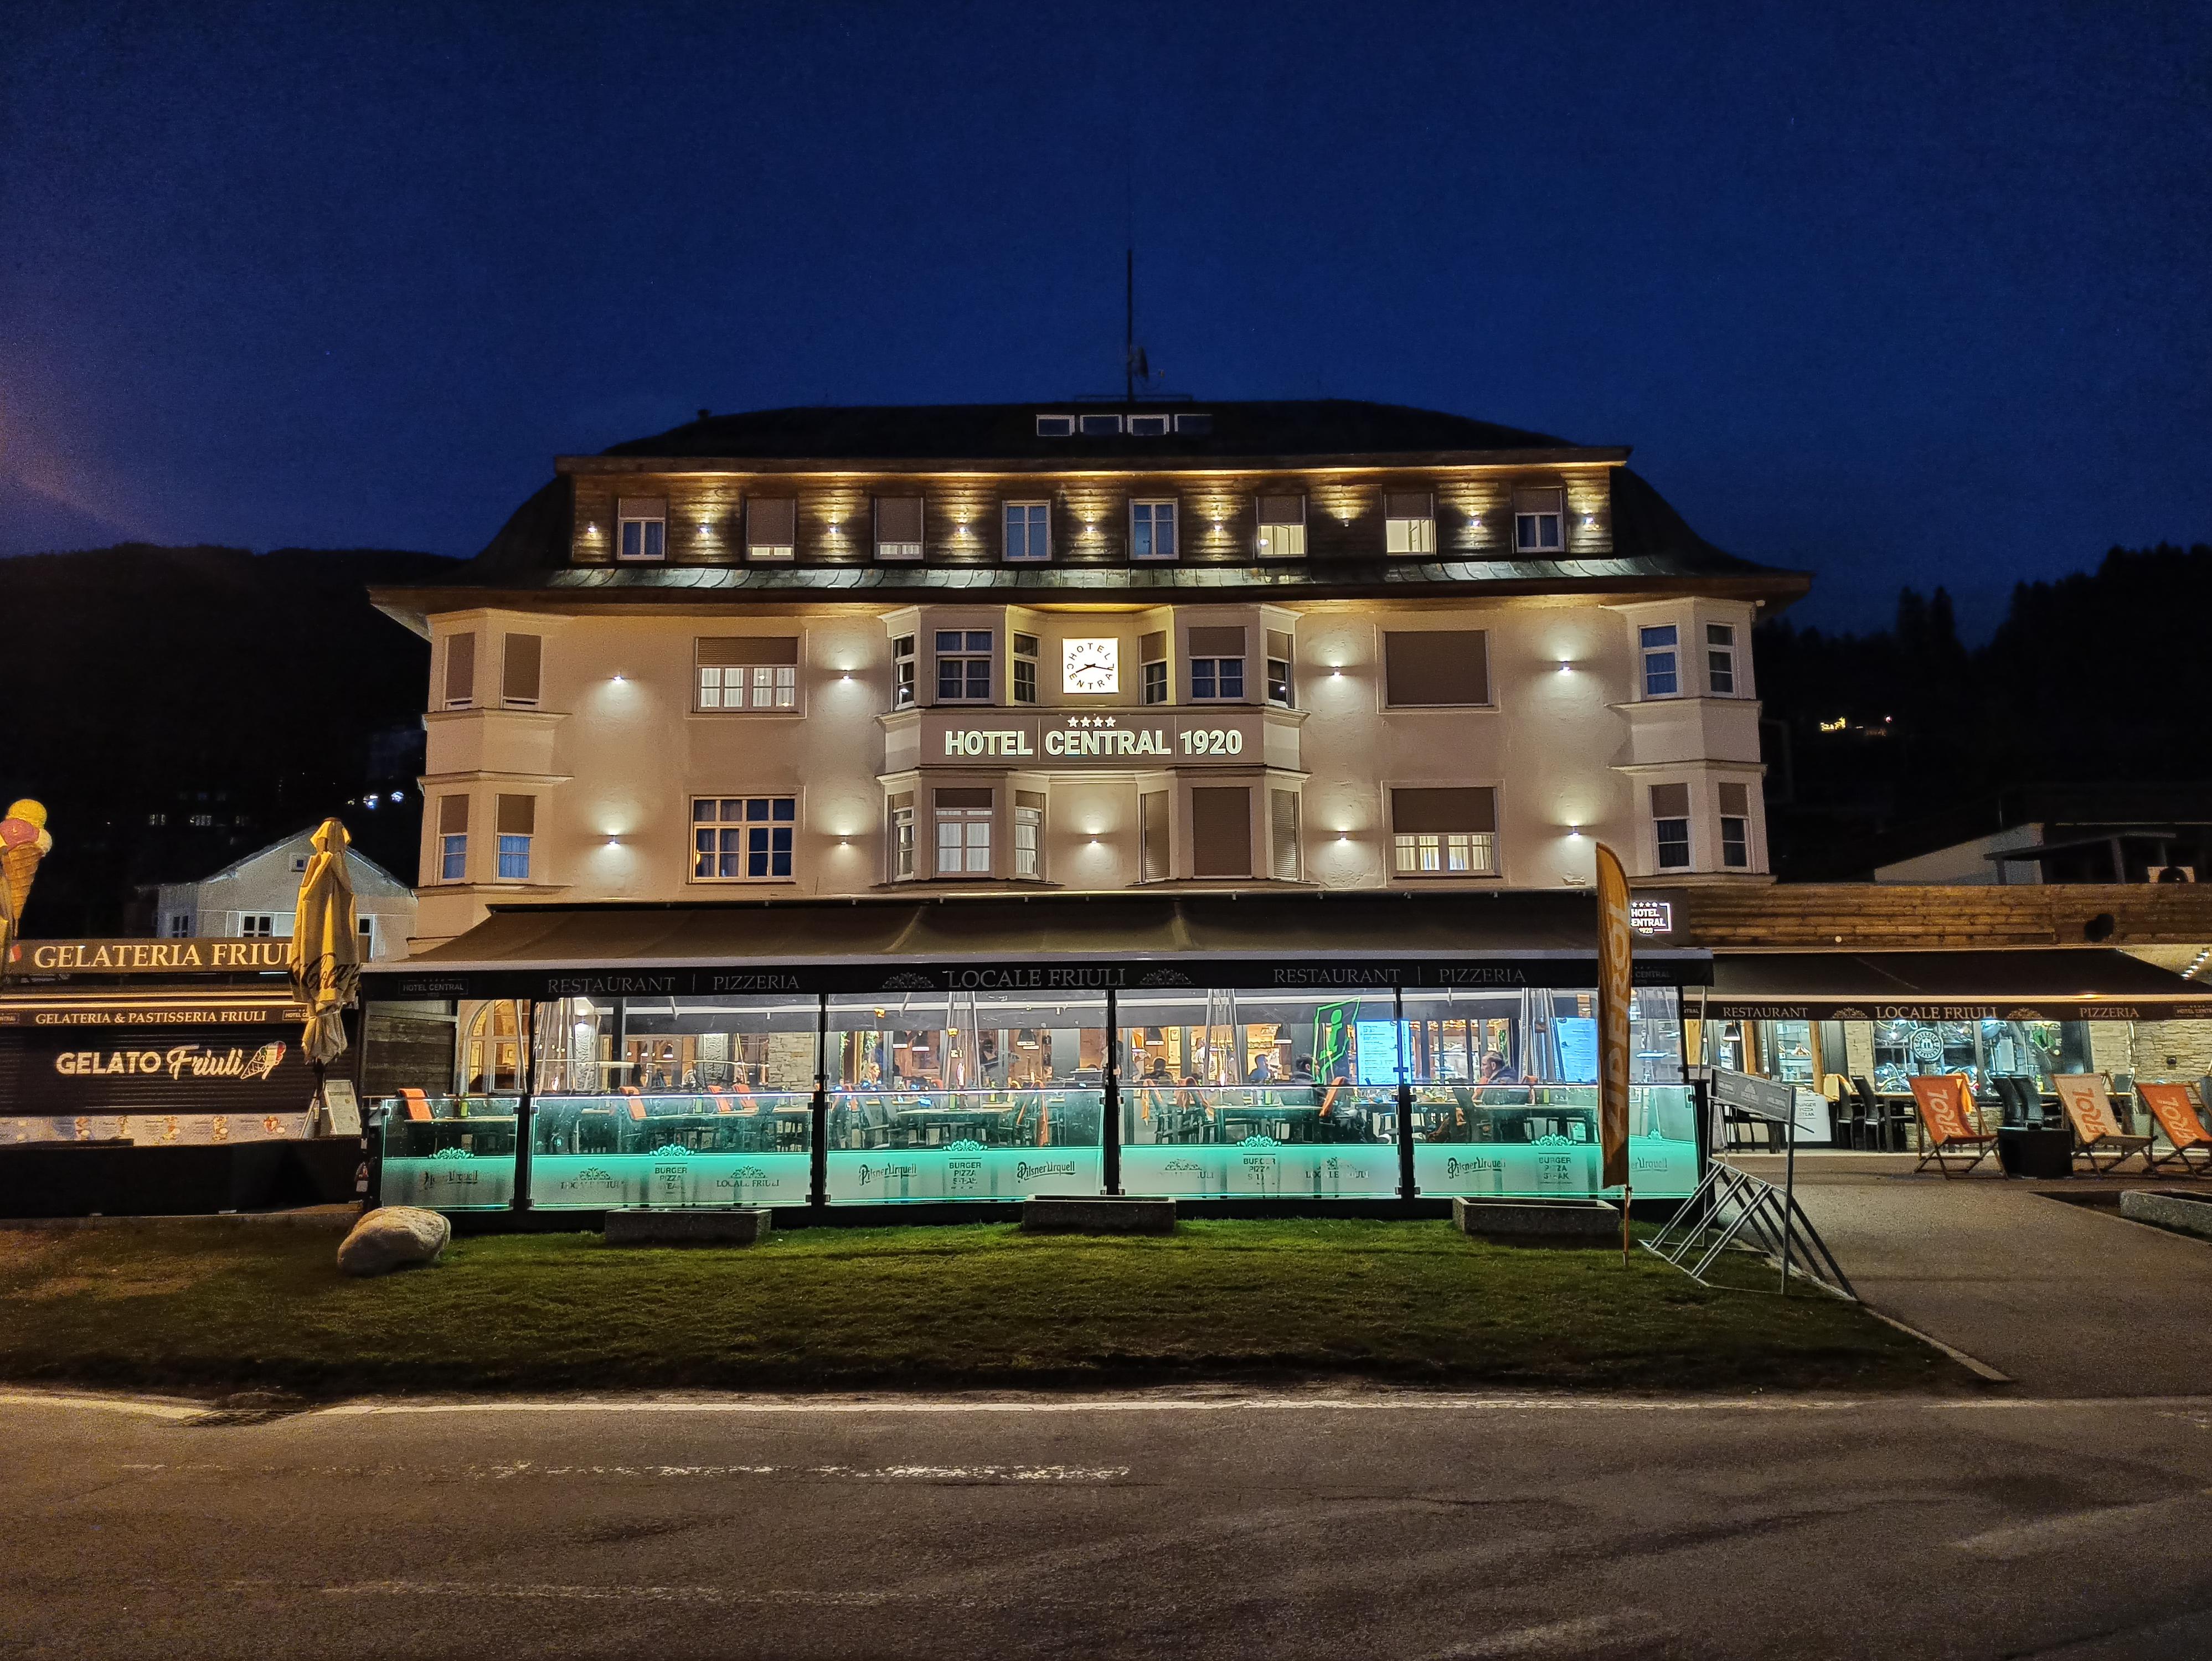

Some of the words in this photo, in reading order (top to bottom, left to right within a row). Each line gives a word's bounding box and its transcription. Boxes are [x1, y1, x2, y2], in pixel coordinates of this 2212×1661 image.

[1069, 643, 1111, 661] HOTEL
[945, 730, 1033, 756] HOTEL
[1045, 730, 1172, 756] CENTRAL
[1180, 730, 1242, 755] 1920
[1631, 909, 1660, 917] HOTEL
[1631, 918, 1666, 926] ENTRAL
[34, 943, 203, 968] GELATERIA
[548, 976, 676, 993] RESTAURANT
[713, 975, 800, 991] PIZZERIA
[946, 969, 1041, 988] LOCALE
[1048, 968, 1126, 986] FRIULI
[1273, 968, 1401, 983] RESTAURANT
[1440, 968, 1527, 983] PIZZERIA
[35, 1013, 111, 1024] GELATERIA
[114, 1013, 127, 1023] &
[128, 1011, 217, 1024] PASTISSERIA
[221, 1010, 266, 1022] FRIULI
[1723, 1007, 1808, 1018] RESTAURANT
[1875, 1007, 1940, 1019] LOCALE
[1943, 1007, 1997, 1019] FRIULI
[2080, 1008, 2140, 1018] PIZZERIA
[56, 1051, 161, 1074] GELATO
[166, 1043, 245, 1080] Friuli
[859, 1164, 888, 1186] Pilsner
[887, 1163, 917, 1179] Urquell
[1017, 1162, 1047, 1183] Pilsner
[1046, 1161, 1075, 1176] Urquell
[1447, 1157, 1477, 1179] Pilsner
